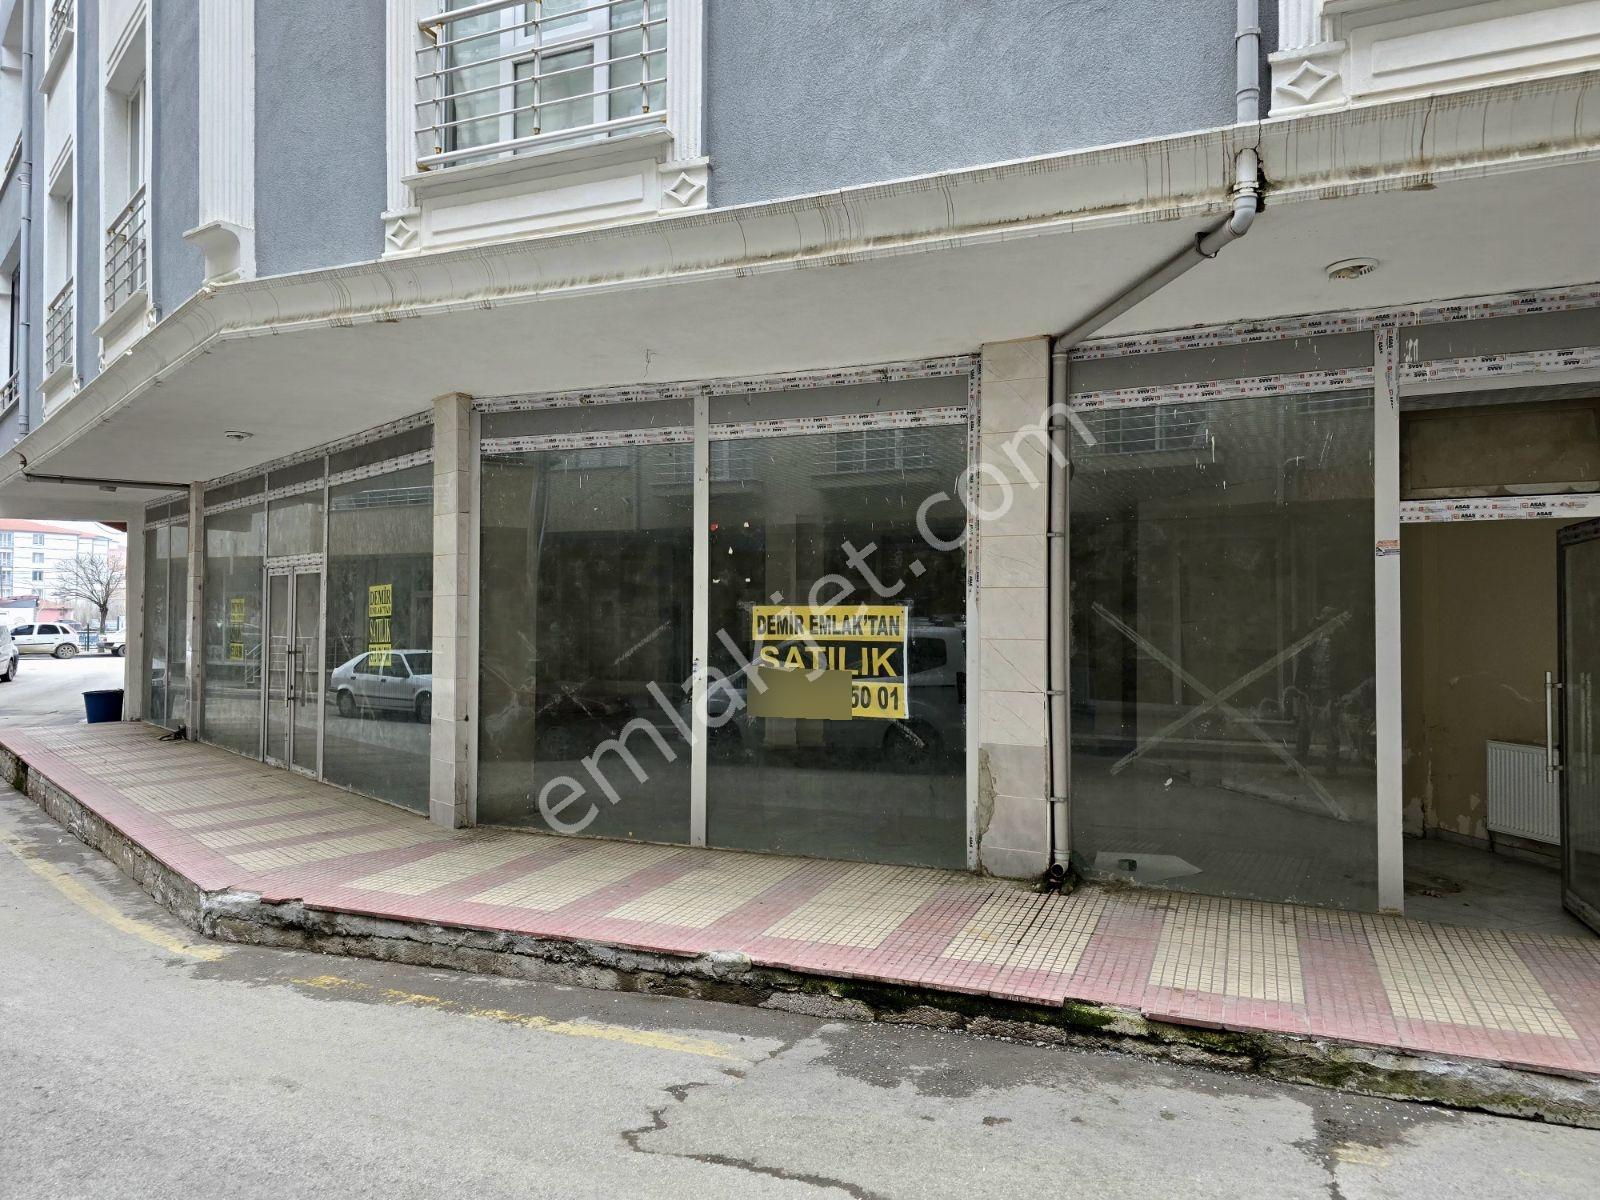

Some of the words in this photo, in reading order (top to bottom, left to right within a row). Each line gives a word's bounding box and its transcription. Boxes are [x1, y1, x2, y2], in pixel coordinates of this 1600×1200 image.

[757, 611, 804, 635] DEMİR
[809, 614, 900, 636] EMLAK'TAN
[757, 645, 898, 677] SATILIK
[877, 686, 899, 710] 01
